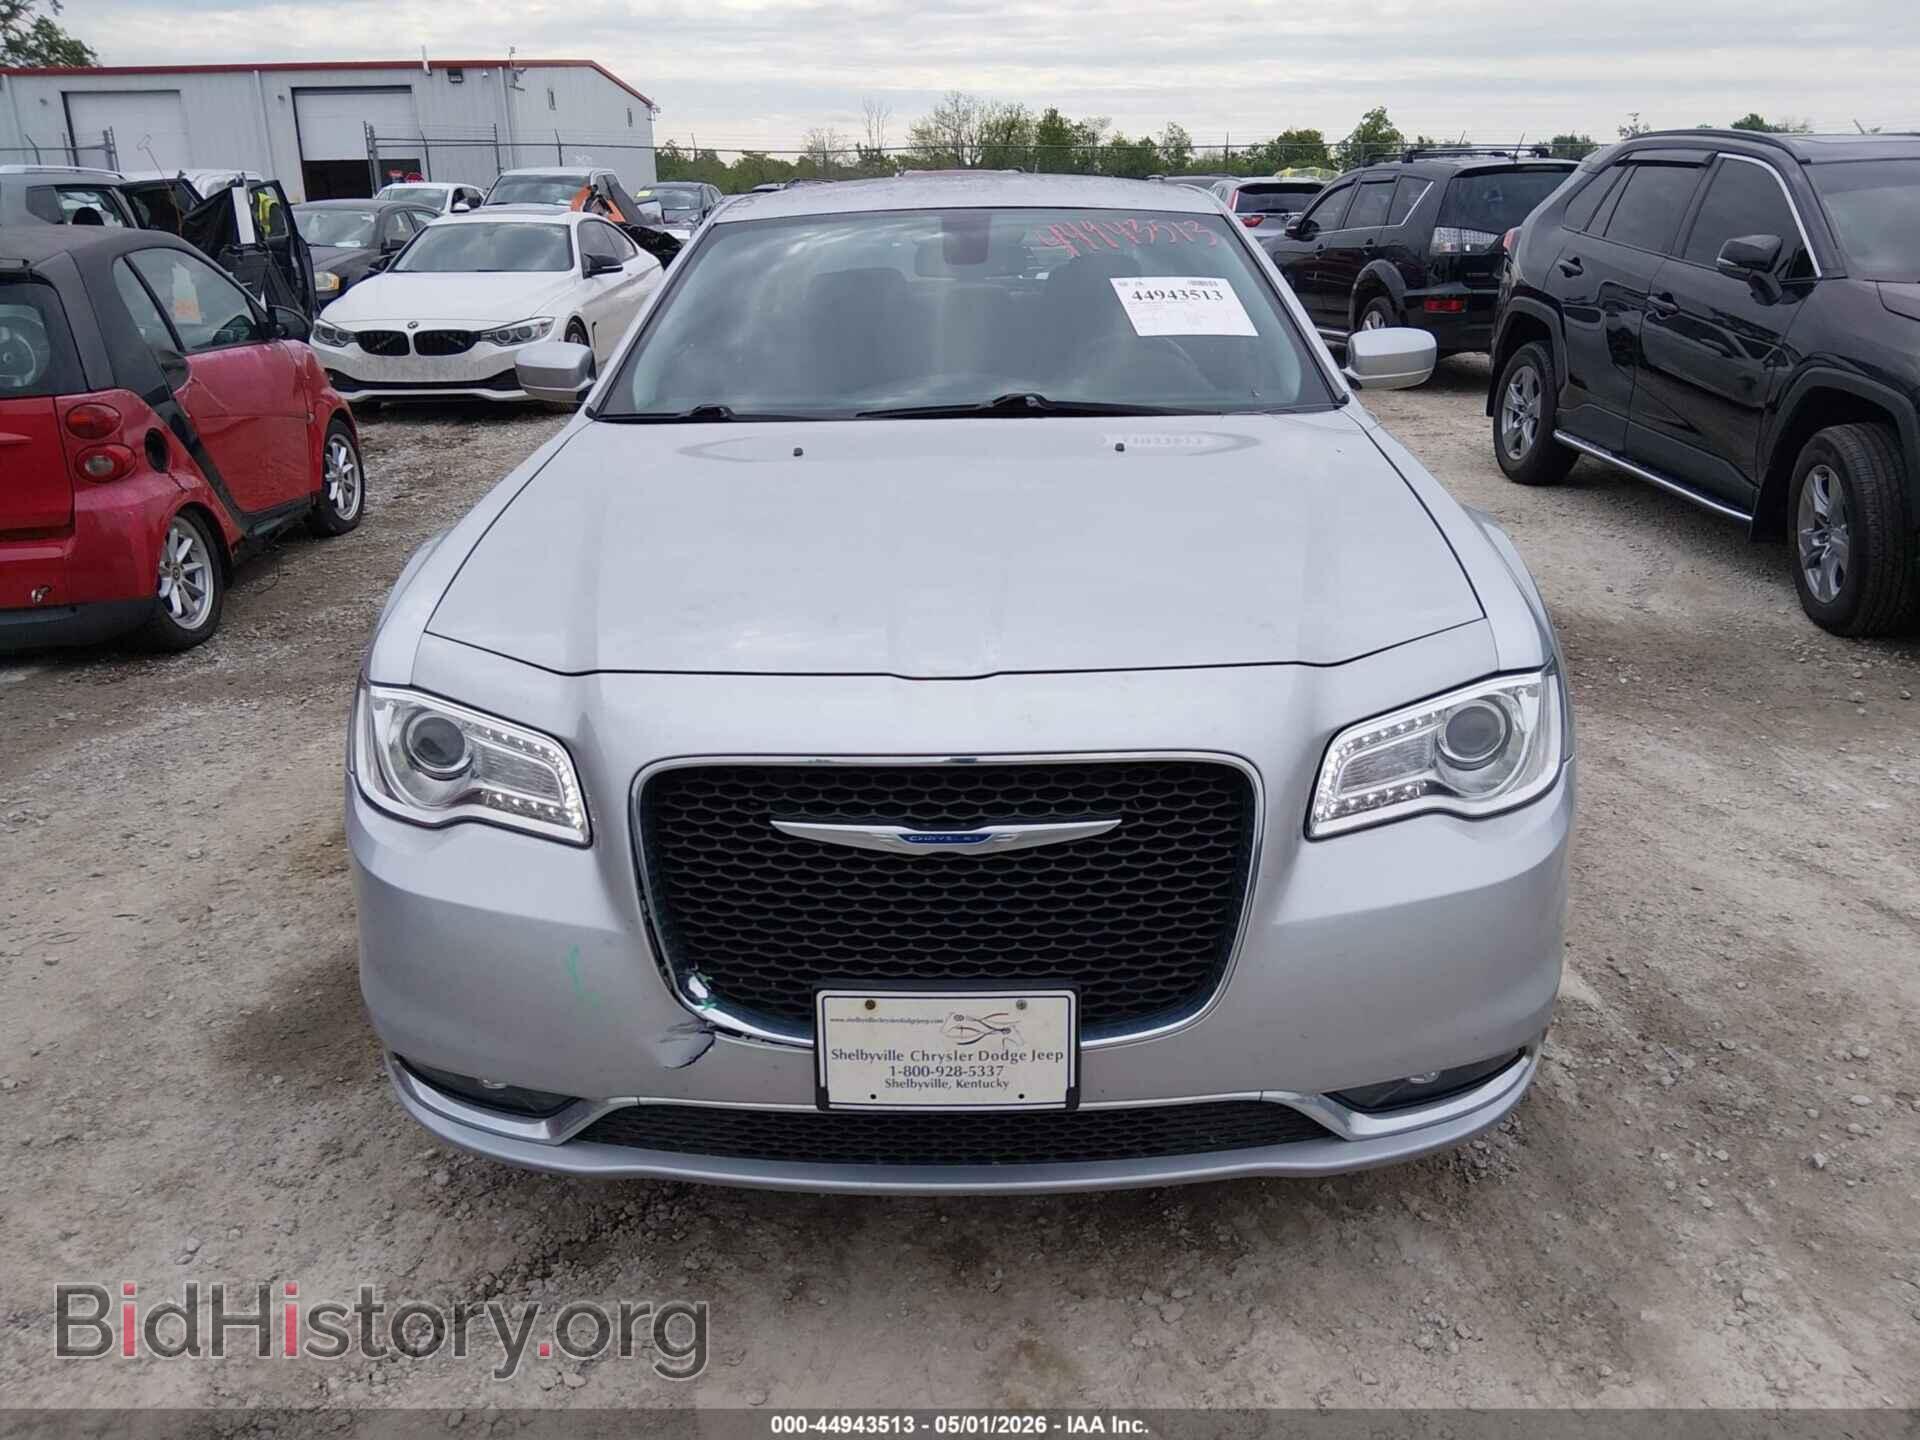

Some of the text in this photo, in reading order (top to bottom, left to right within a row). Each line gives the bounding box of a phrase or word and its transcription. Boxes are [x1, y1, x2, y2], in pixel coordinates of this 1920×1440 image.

[1131, 289, 1224, 301] 44943513
[831, 1049, 1064, 1064] Shelbyville Chrysler Dodge Jeep
[889, 1065, 1004, 1077] 1-800-928-5337
[884, 1078, 1009, 1089] Shelbyville, Kentucky
